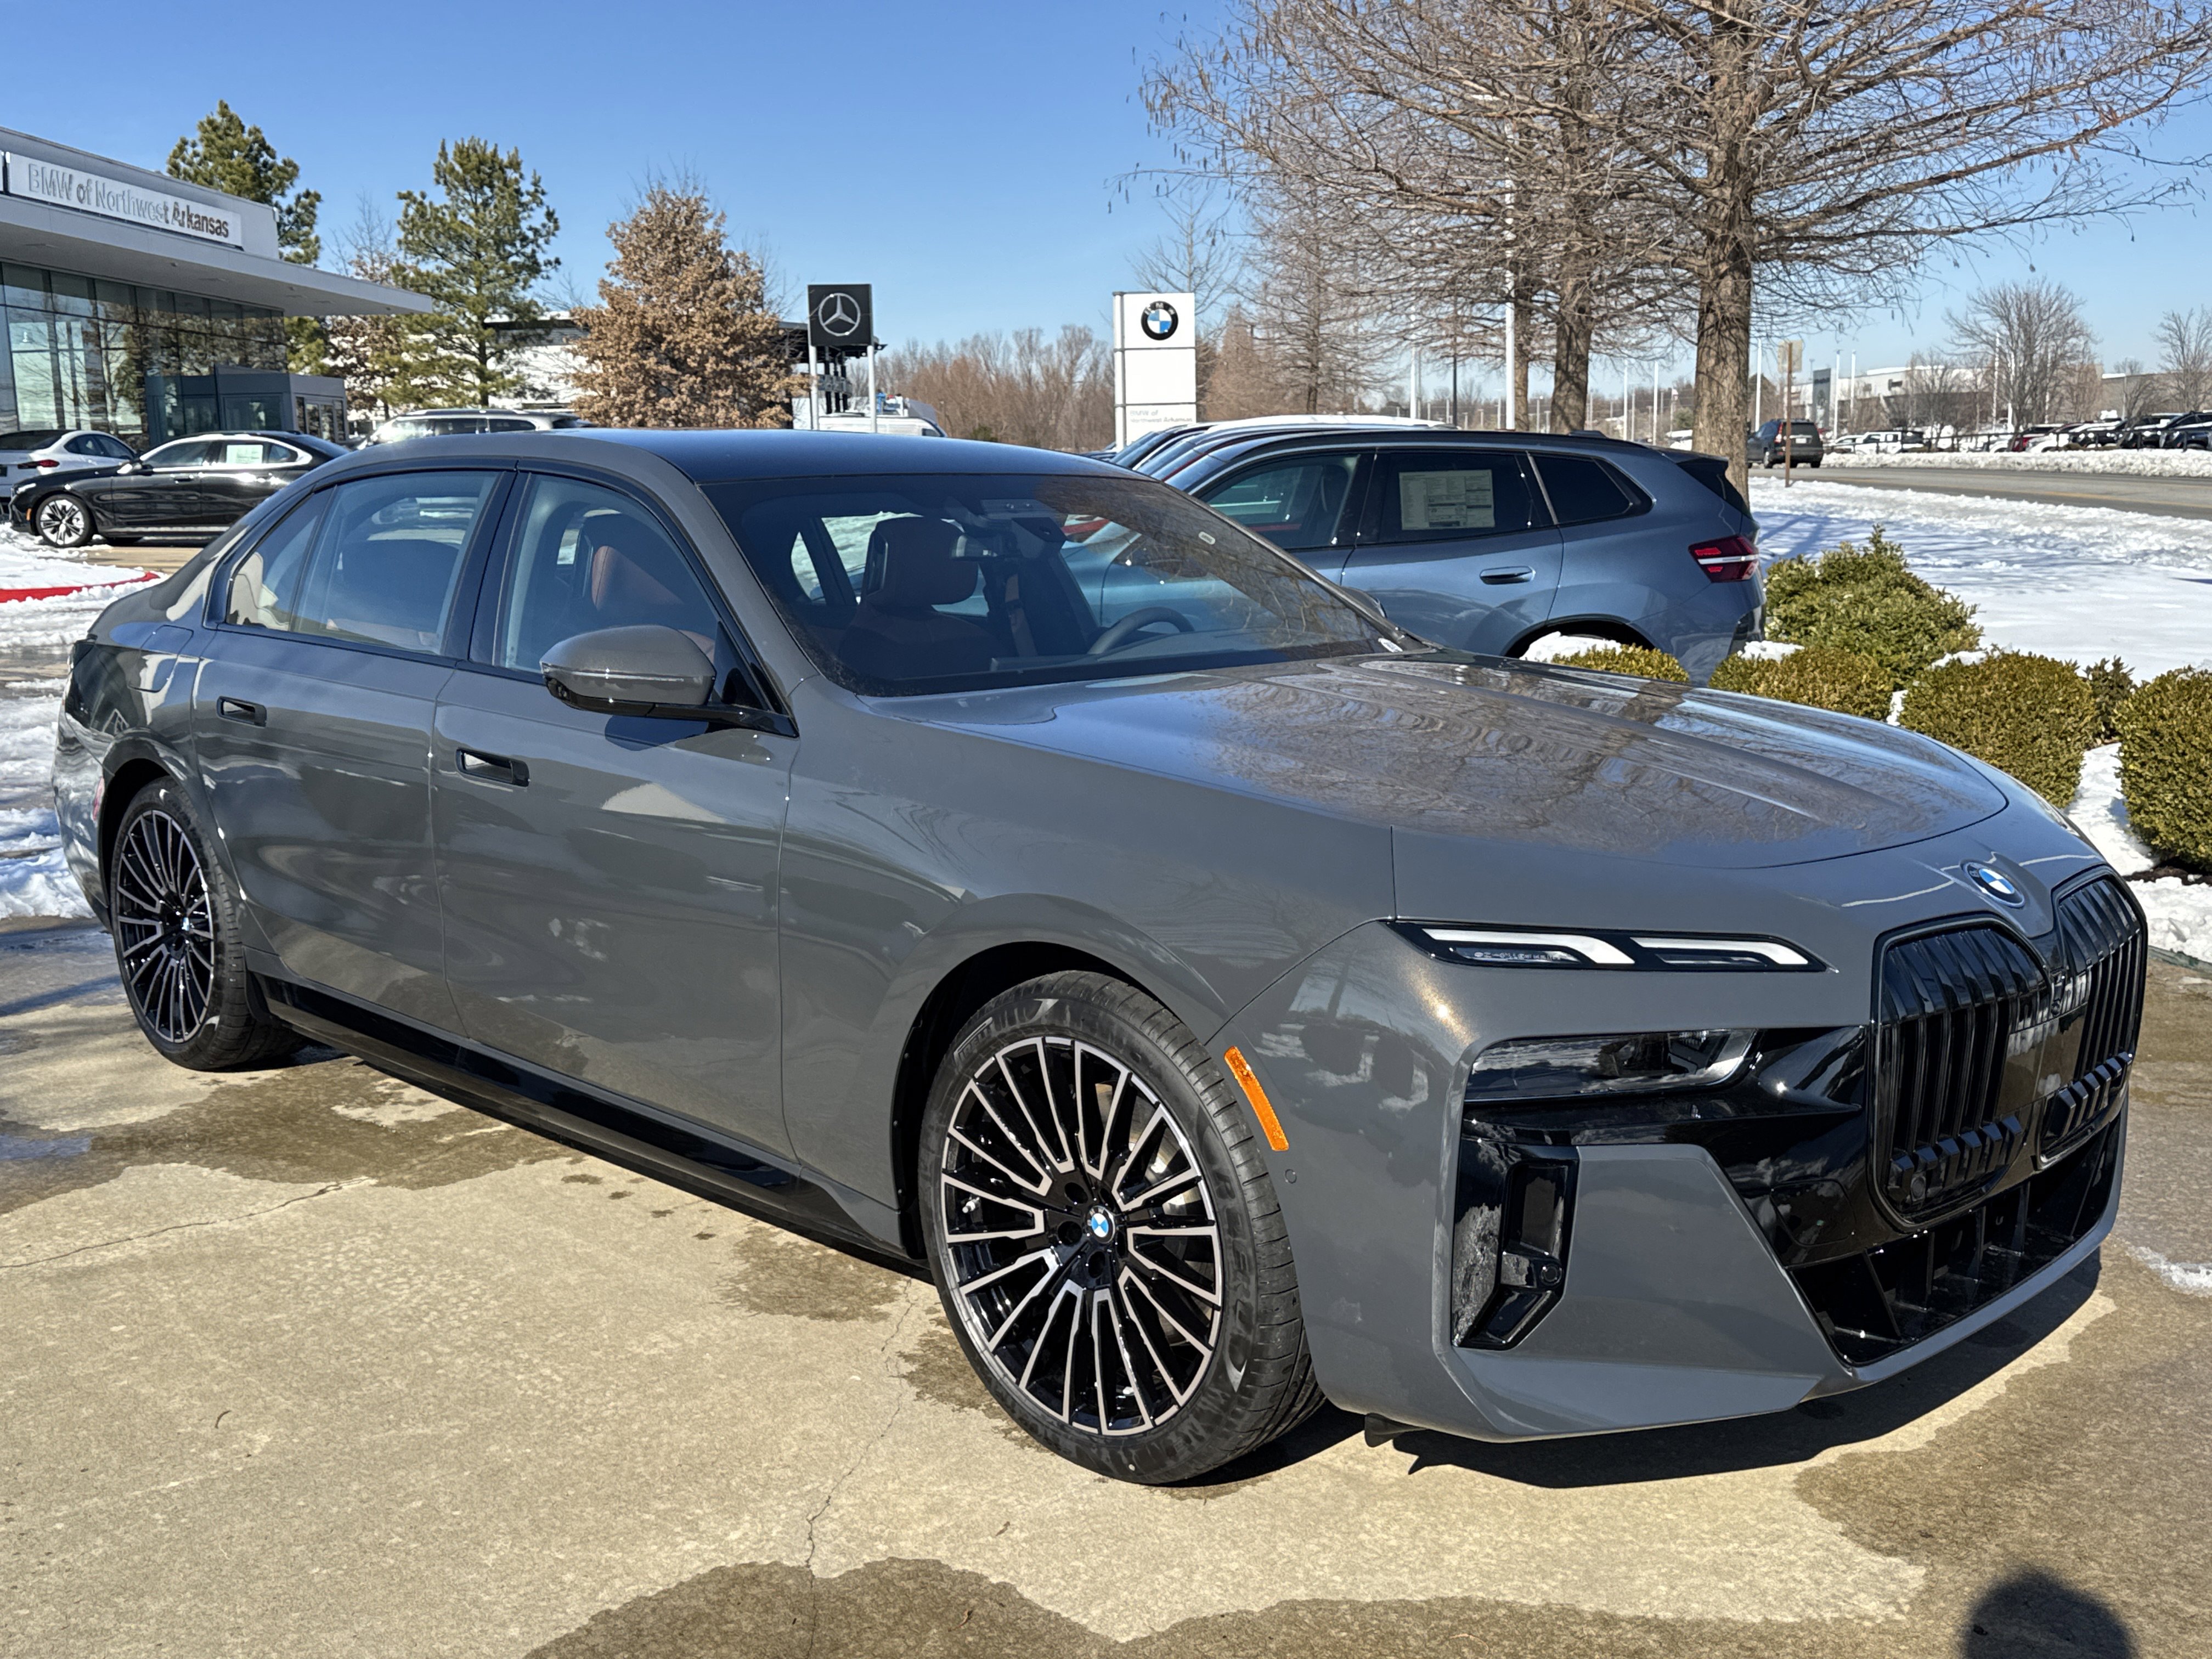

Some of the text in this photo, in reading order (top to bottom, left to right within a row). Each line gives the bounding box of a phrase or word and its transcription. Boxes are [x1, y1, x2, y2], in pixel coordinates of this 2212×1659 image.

[29, 163, 229, 238] BMW of Northwest Arkansas
